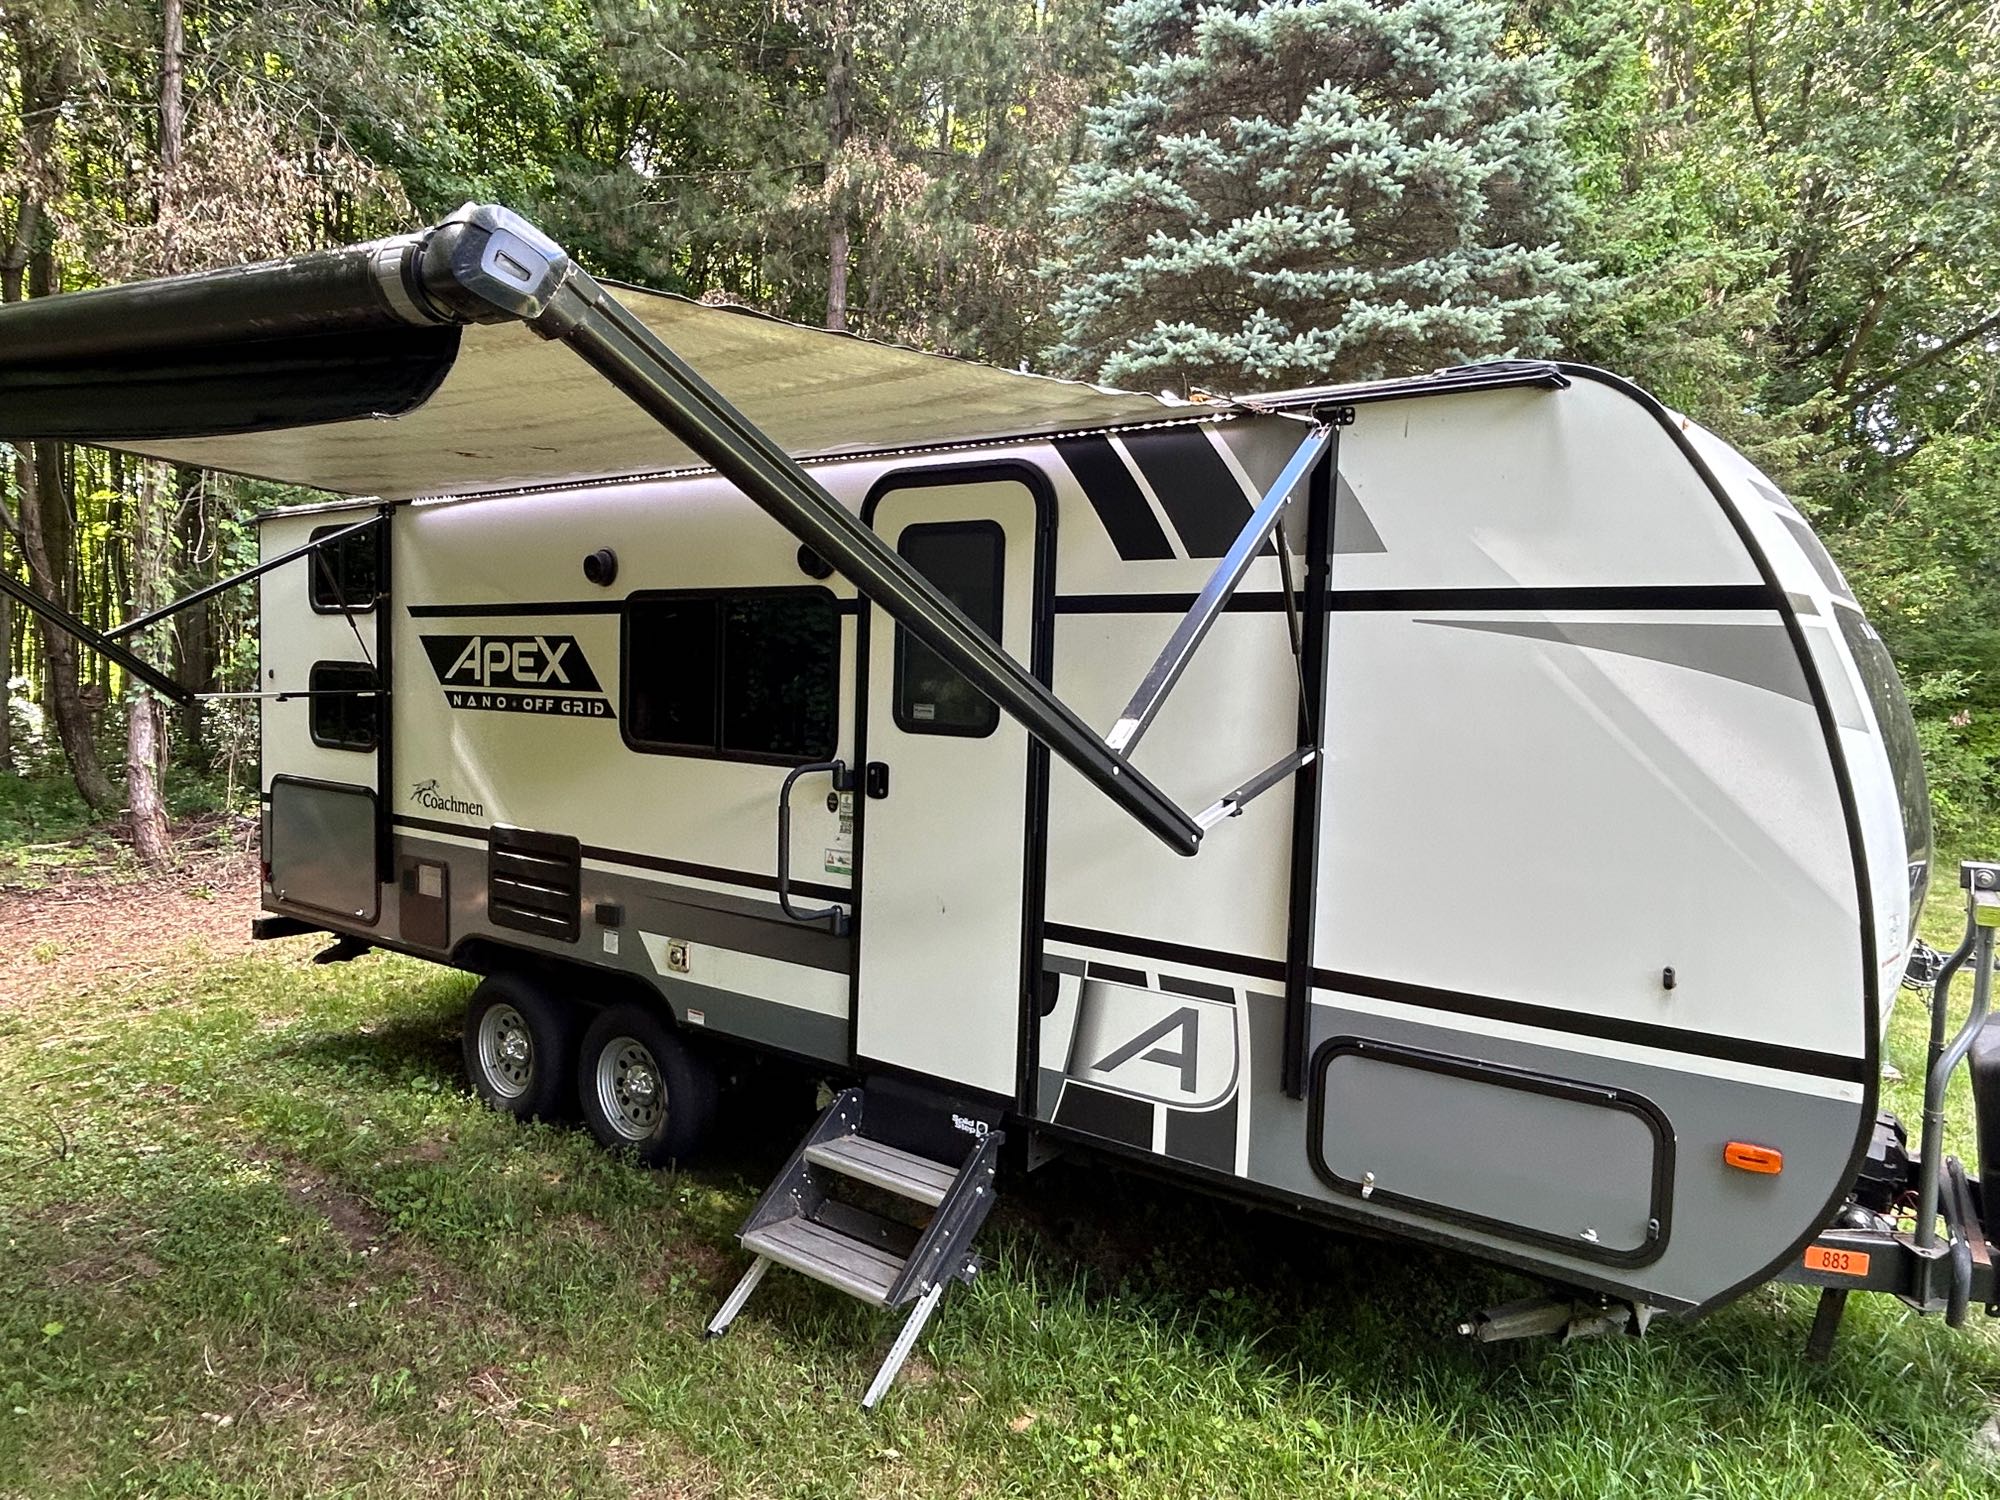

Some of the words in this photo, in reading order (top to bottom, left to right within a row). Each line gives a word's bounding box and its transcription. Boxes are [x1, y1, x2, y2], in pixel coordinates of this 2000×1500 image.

[444, 636, 571, 687] APEX
[453, 694, 507, 708] NANO
[522, 698, 554, 711] OFF
[561, 700, 604, 715] GRID
[423, 792, 484, 817] Coachmen
[1092, 1006, 1199, 1094] A
[952, 1114, 975, 1127] Solid
[1822, 1251, 1850, 1271] 883
